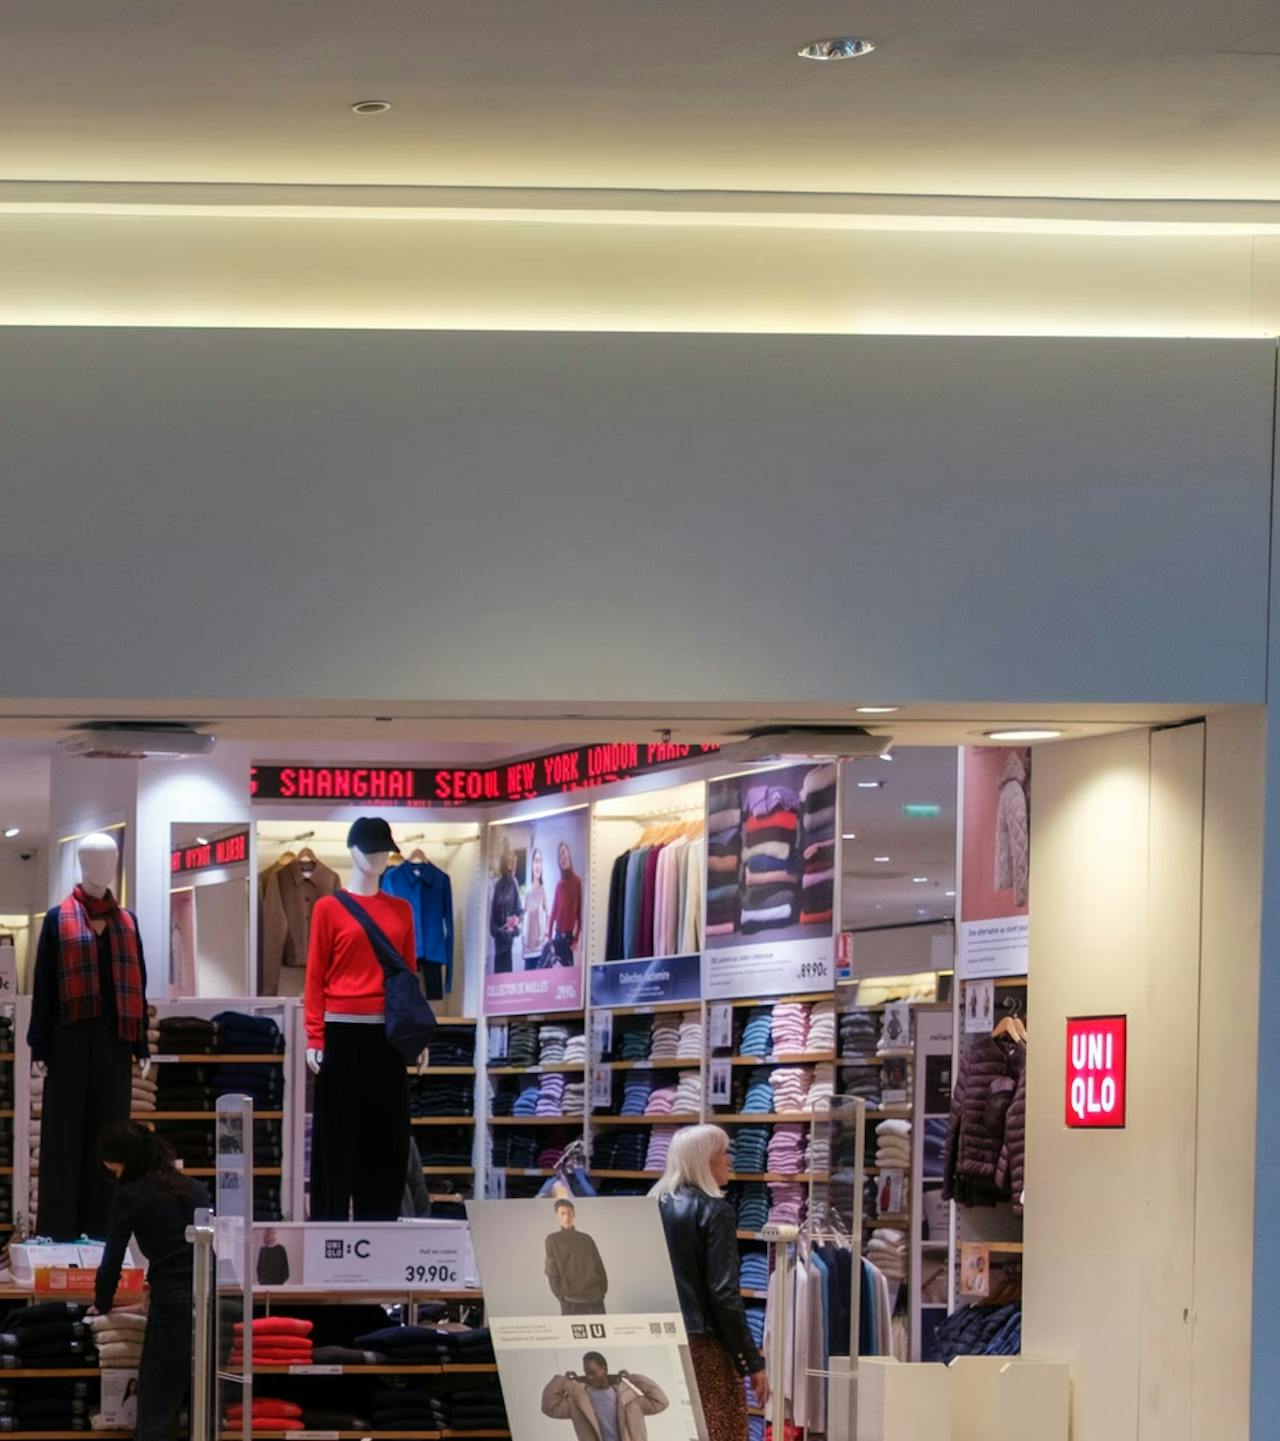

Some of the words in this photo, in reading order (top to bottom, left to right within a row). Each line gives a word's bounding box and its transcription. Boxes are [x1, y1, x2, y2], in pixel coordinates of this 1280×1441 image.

[280, 768, 414, 798] SHANGHAI
[435, 770, 500, 800] SEOUL
[506, 763, 535, 793] NEW
[544, 752, 579, 784] YORK
[587, 743, 639, 777] LONDON
[1072, 1033, 1112, 1070] UNI
[1071, 1076, 1115, 1119] QLO
[405, 1265, 457, 1283] 39,90€
